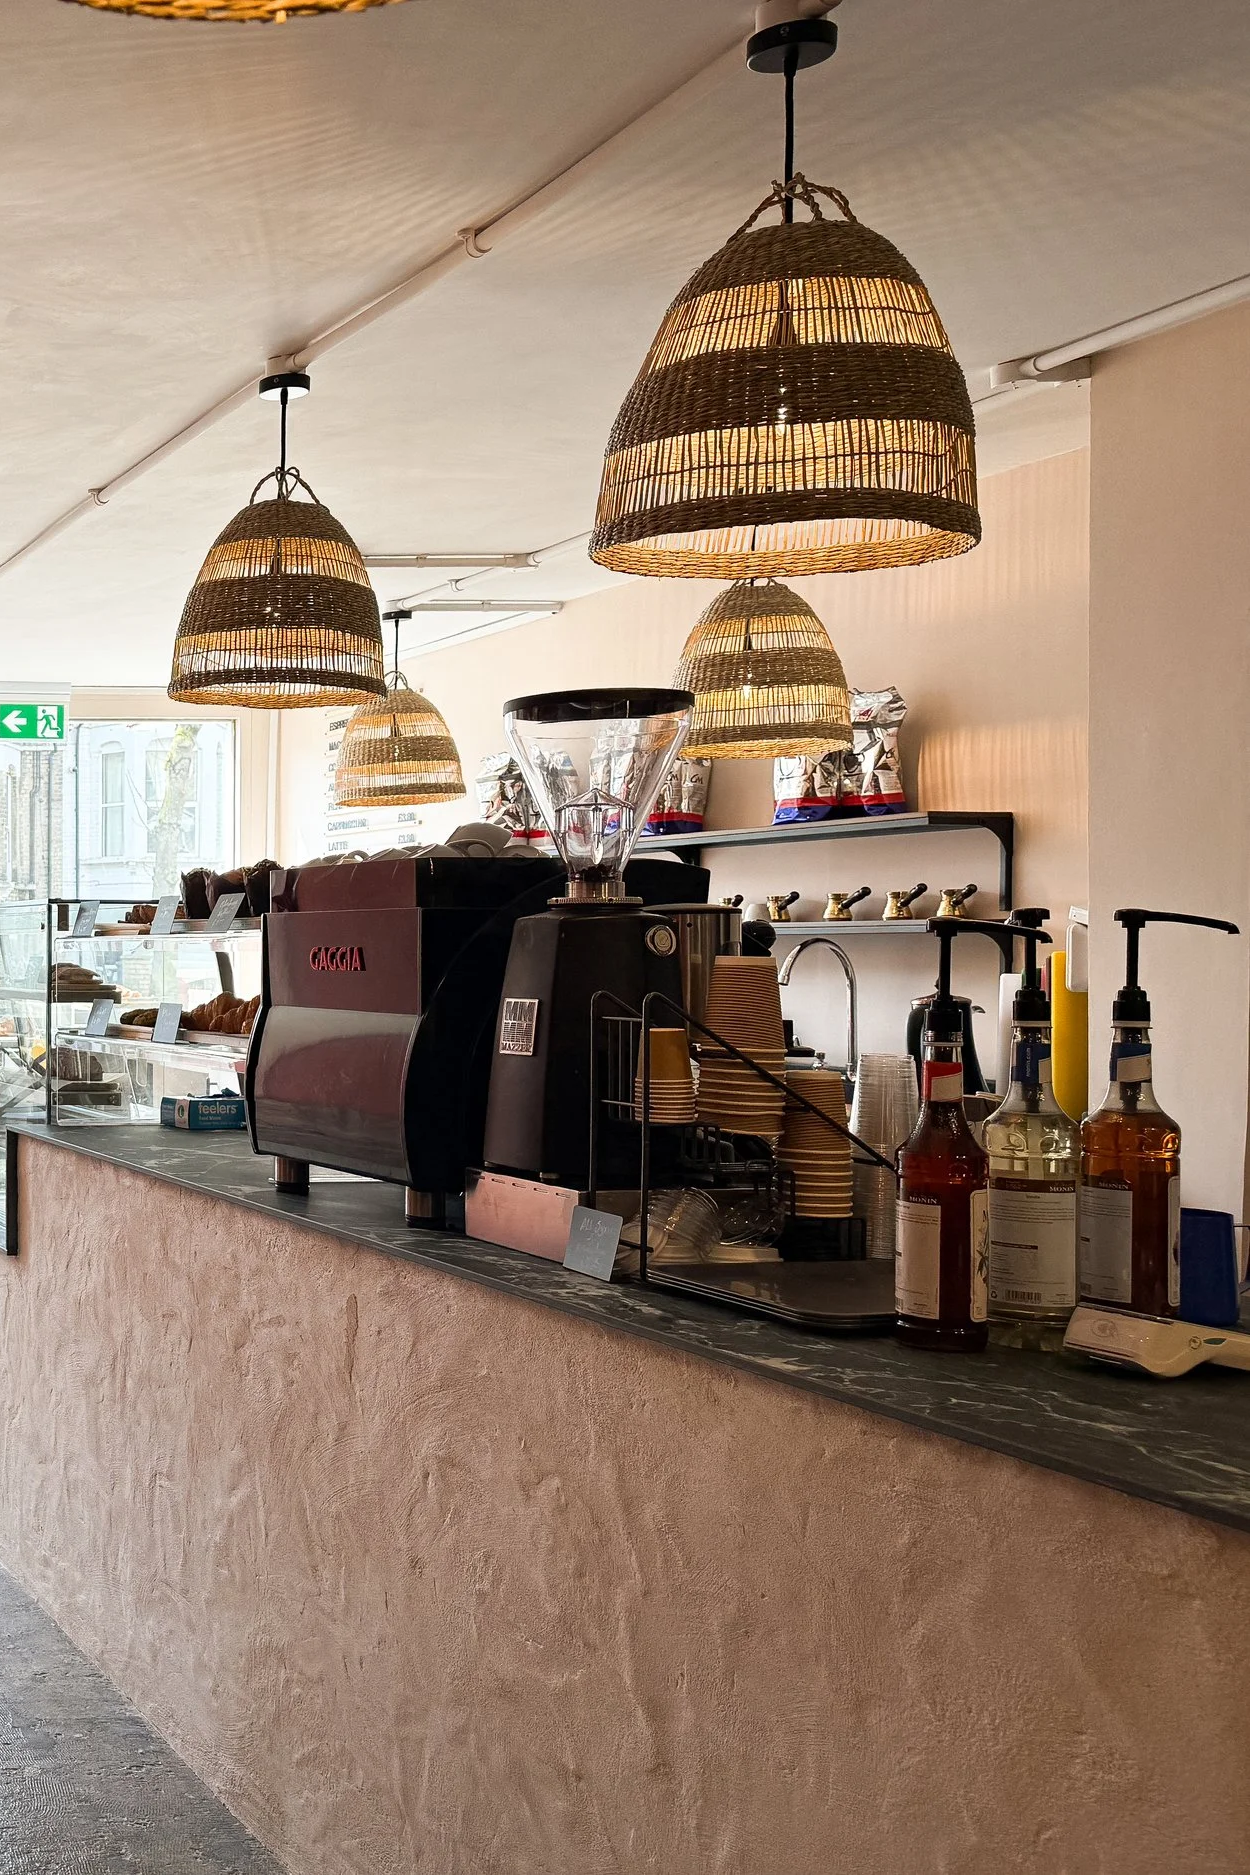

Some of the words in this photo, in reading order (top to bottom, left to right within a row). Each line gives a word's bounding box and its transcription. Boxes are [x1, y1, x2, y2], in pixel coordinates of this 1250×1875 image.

[328, 840, 348, 851] LATTE
[309, 946, 363, 971] GAGGIA
[501, 1042, 533, 1053] MAZZER
[198, 1101, 238, 1114] feelers
[1098, 1182, 1129, 1190] MONIN
[909, 1195, 938, 1204] MONIN
